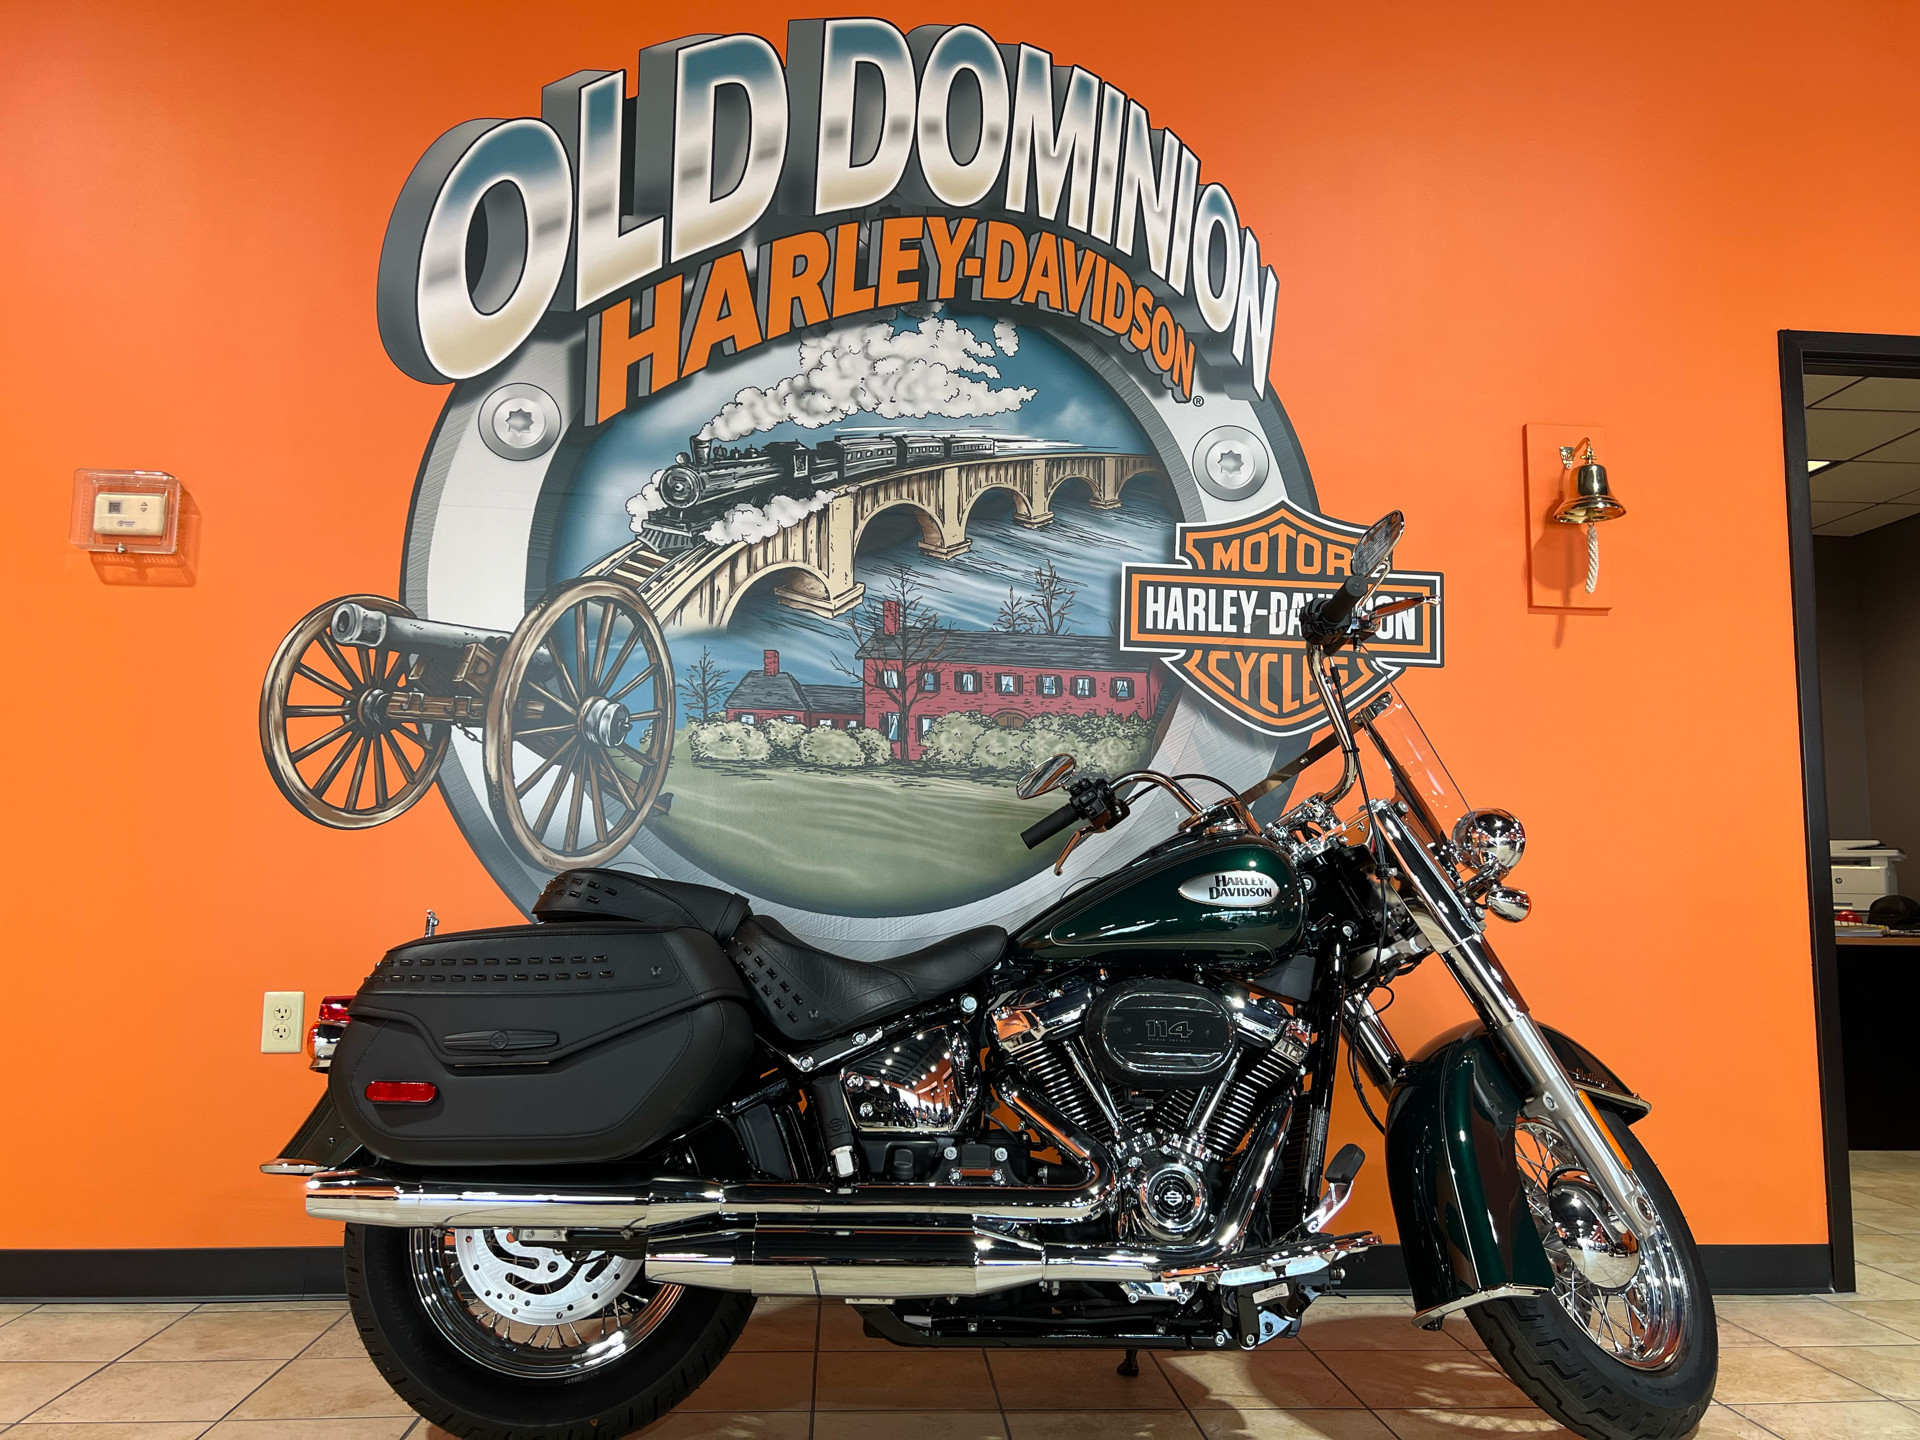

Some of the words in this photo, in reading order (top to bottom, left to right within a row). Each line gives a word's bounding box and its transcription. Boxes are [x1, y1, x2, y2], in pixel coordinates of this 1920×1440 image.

[414, 32, 791, 381] OLD
[813, 16, 1280, 401] DOMINION
[592, 216, 1196, 425] HARLEY-DAVIDSON
[1211, 522, 1353, 577] MOTOR
[1145, 585, 1416, 640] HARLEY-DAON
[1208, 886, 1273, 900] DAVIDSON
[1145, 1019, 1194, 1039] 114
